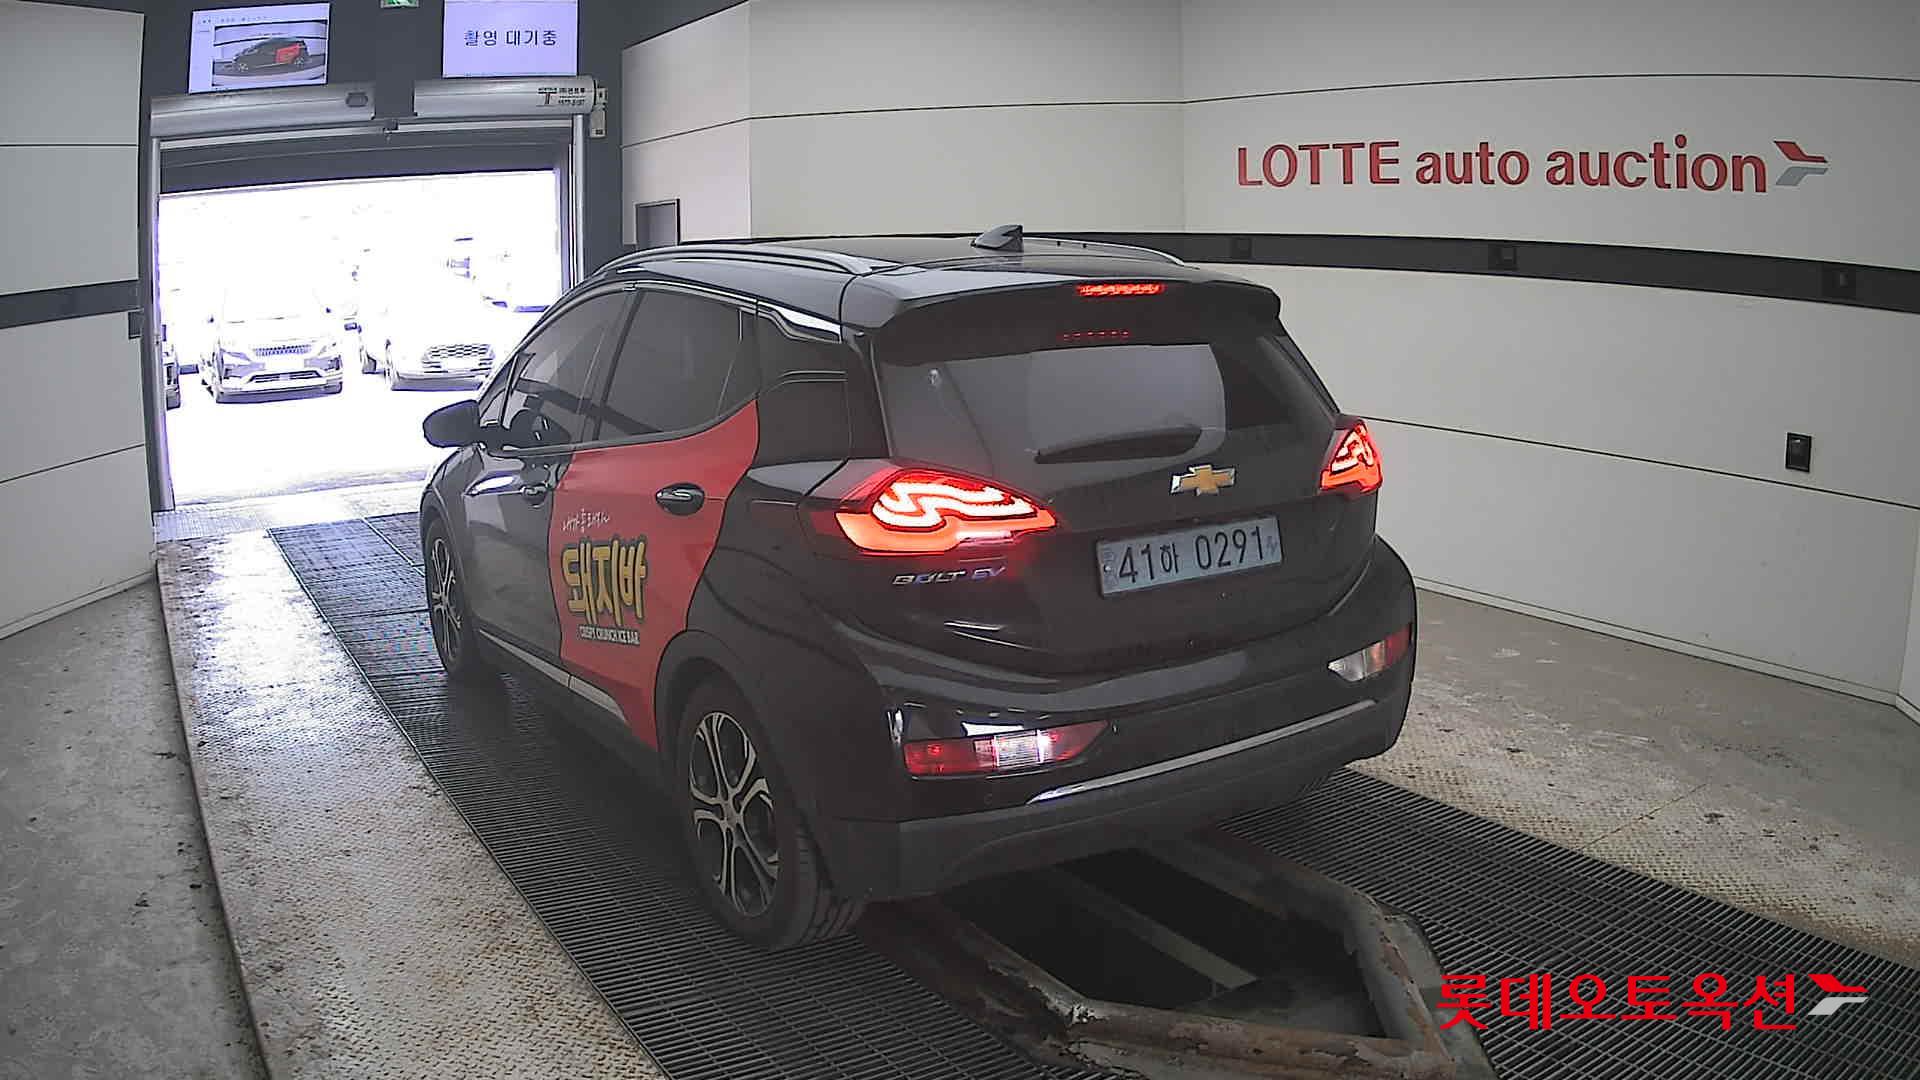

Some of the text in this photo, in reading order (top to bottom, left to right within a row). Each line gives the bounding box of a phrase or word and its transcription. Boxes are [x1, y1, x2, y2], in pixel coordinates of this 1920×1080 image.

[464, 29, 557, 47] 촬영 대기중
[1237, 134, 1767, 193] LOTTE auto auction
[561, 536, 648, 627] 돼지바
[892, 565, 1006, 585] BOLT EV
[1118, 543, 1180, 584] 41하
[1195, 525, 1264, 570] 0291
